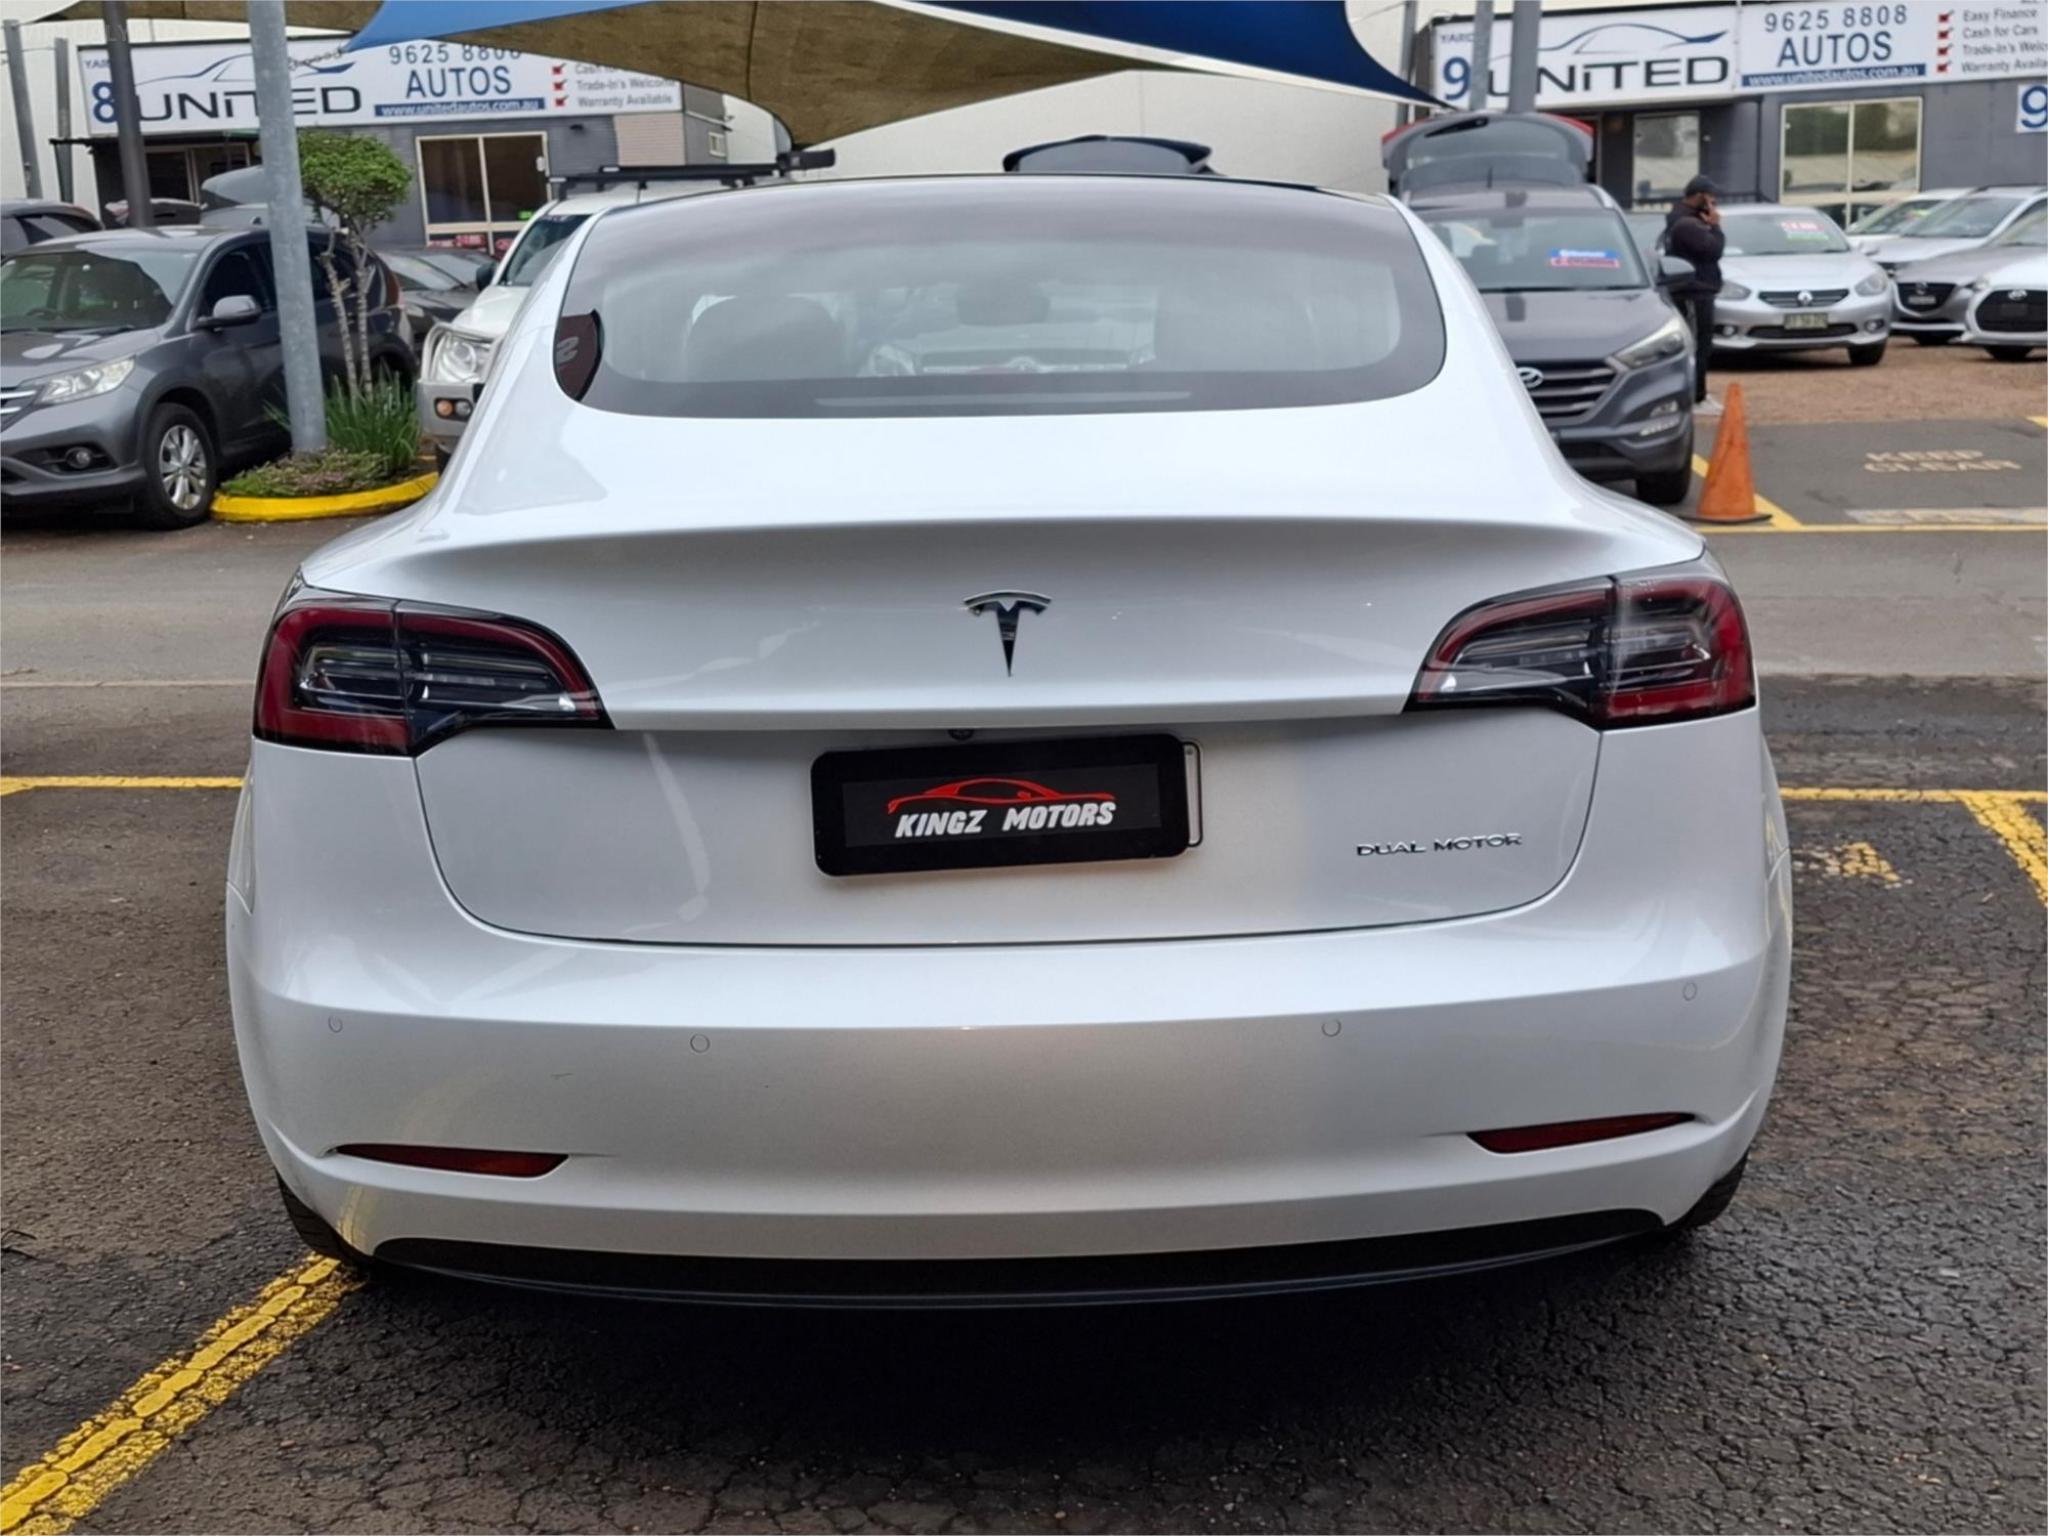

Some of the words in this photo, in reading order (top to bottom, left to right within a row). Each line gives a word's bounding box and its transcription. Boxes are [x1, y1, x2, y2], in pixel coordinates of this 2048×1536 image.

[1764, 9, 1829, 33] 9625
[1842, 4, 1907, 28] 8808
[85, 59, 111, 69] YAR
[388, 44, 449, 65] 9625
[1777, 30, 1892, 67] AUTOS
[405, 65, 512, 98] AUTOS
[1443, 57, 1472, 100] 9
[92, 81, 117, 123] 8
[381, 100, 539, 116] www.unitedautos.com.au
[894, 809, 988, 838] KINGZ
[1001, 801, 1117, 832] MOTORS
[1356, 840, 1427, 856] DUAL
[1433, 832, 1522, 852] MOTOR
